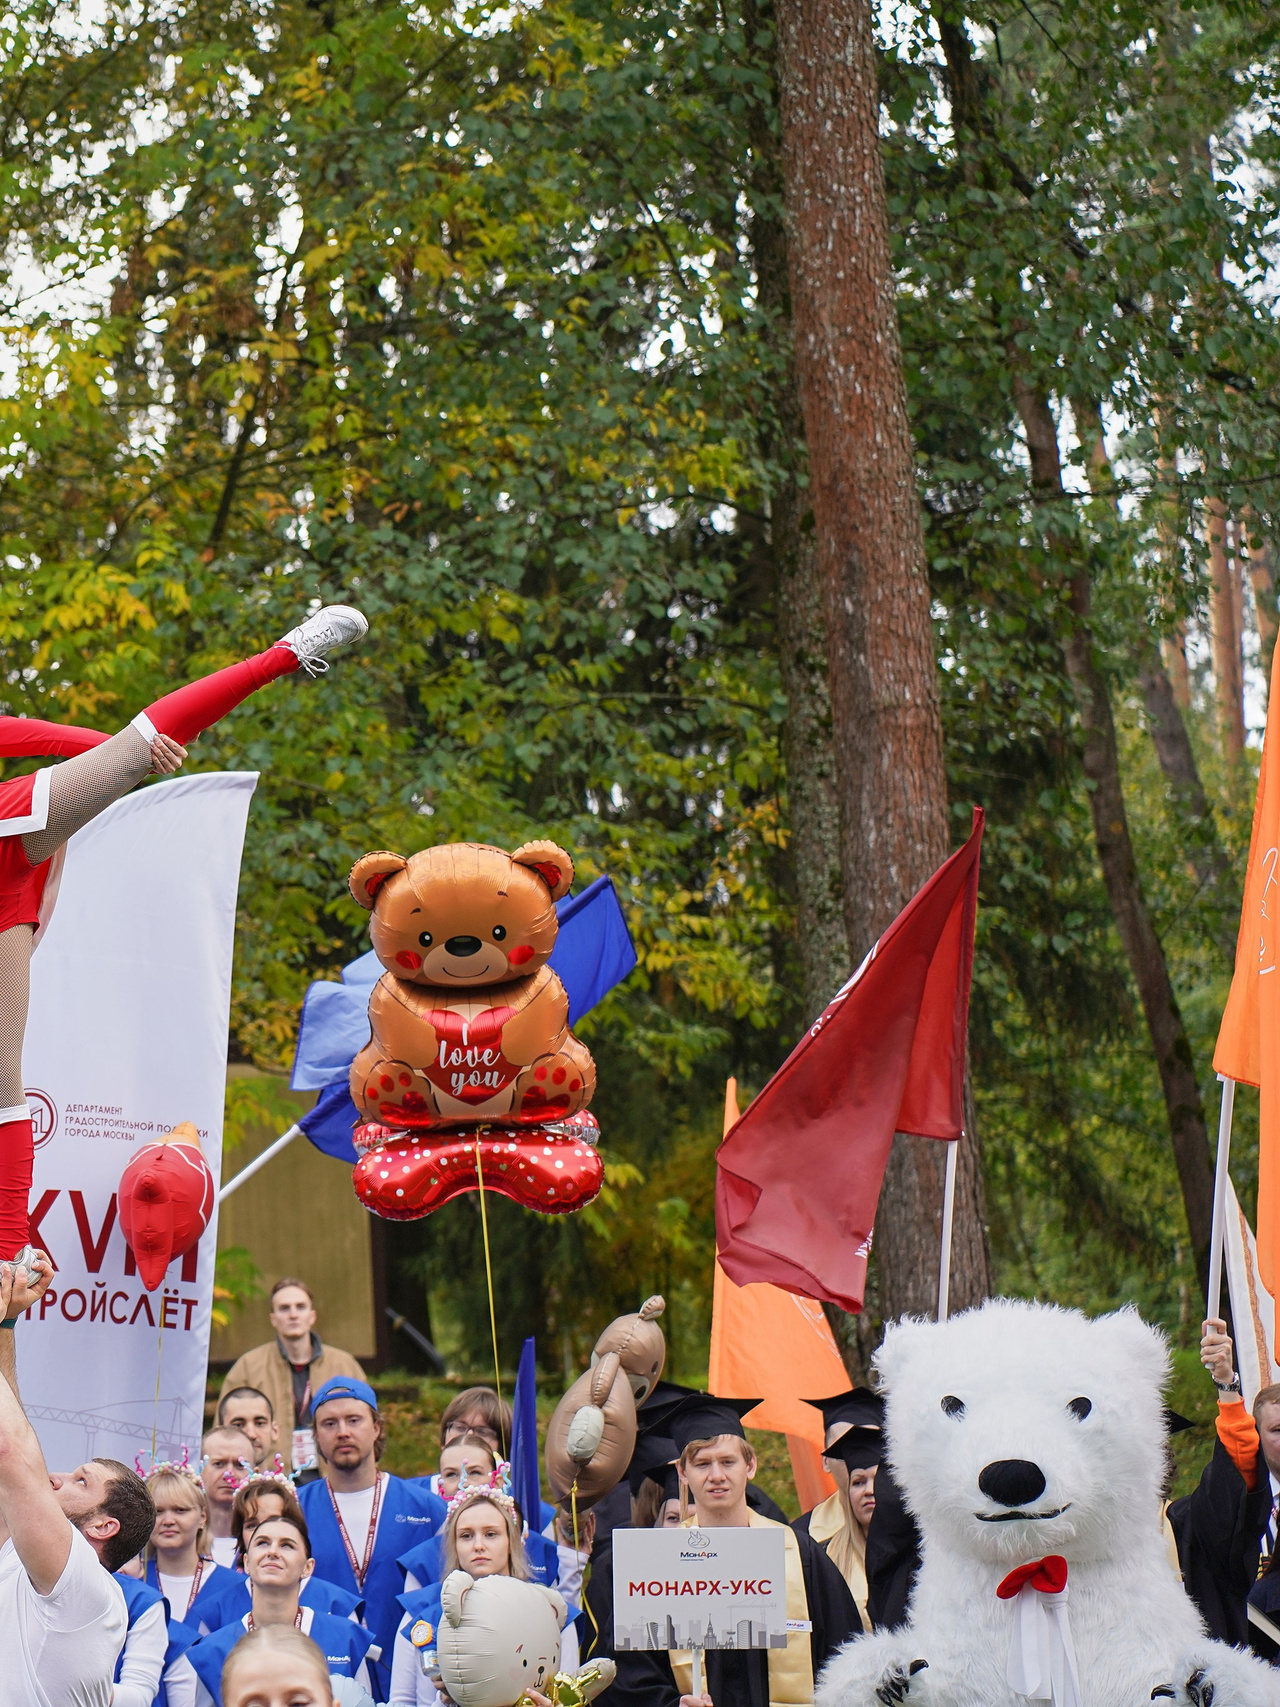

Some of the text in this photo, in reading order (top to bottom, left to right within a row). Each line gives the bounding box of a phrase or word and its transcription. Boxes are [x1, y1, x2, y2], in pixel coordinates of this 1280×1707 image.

[462, 1023, 468, 1046] I
[440, 1040, 500, 1069] love
[451, 1070, 506, 1096] you
[65, 1104, 123, 1115] ДЕПАРТАМЕНТ
[65, 1116, 154, 1132] ГРАДОСТРОИТЕЛЬНОЙ
[64, 1128, 135, 1141] ГОРОДА МОСКВЫ
[25, 1281, 198, 1331] РОЙСЛЁТ
[628, 1580, 772, 1597] МОНАРХ-УКС
